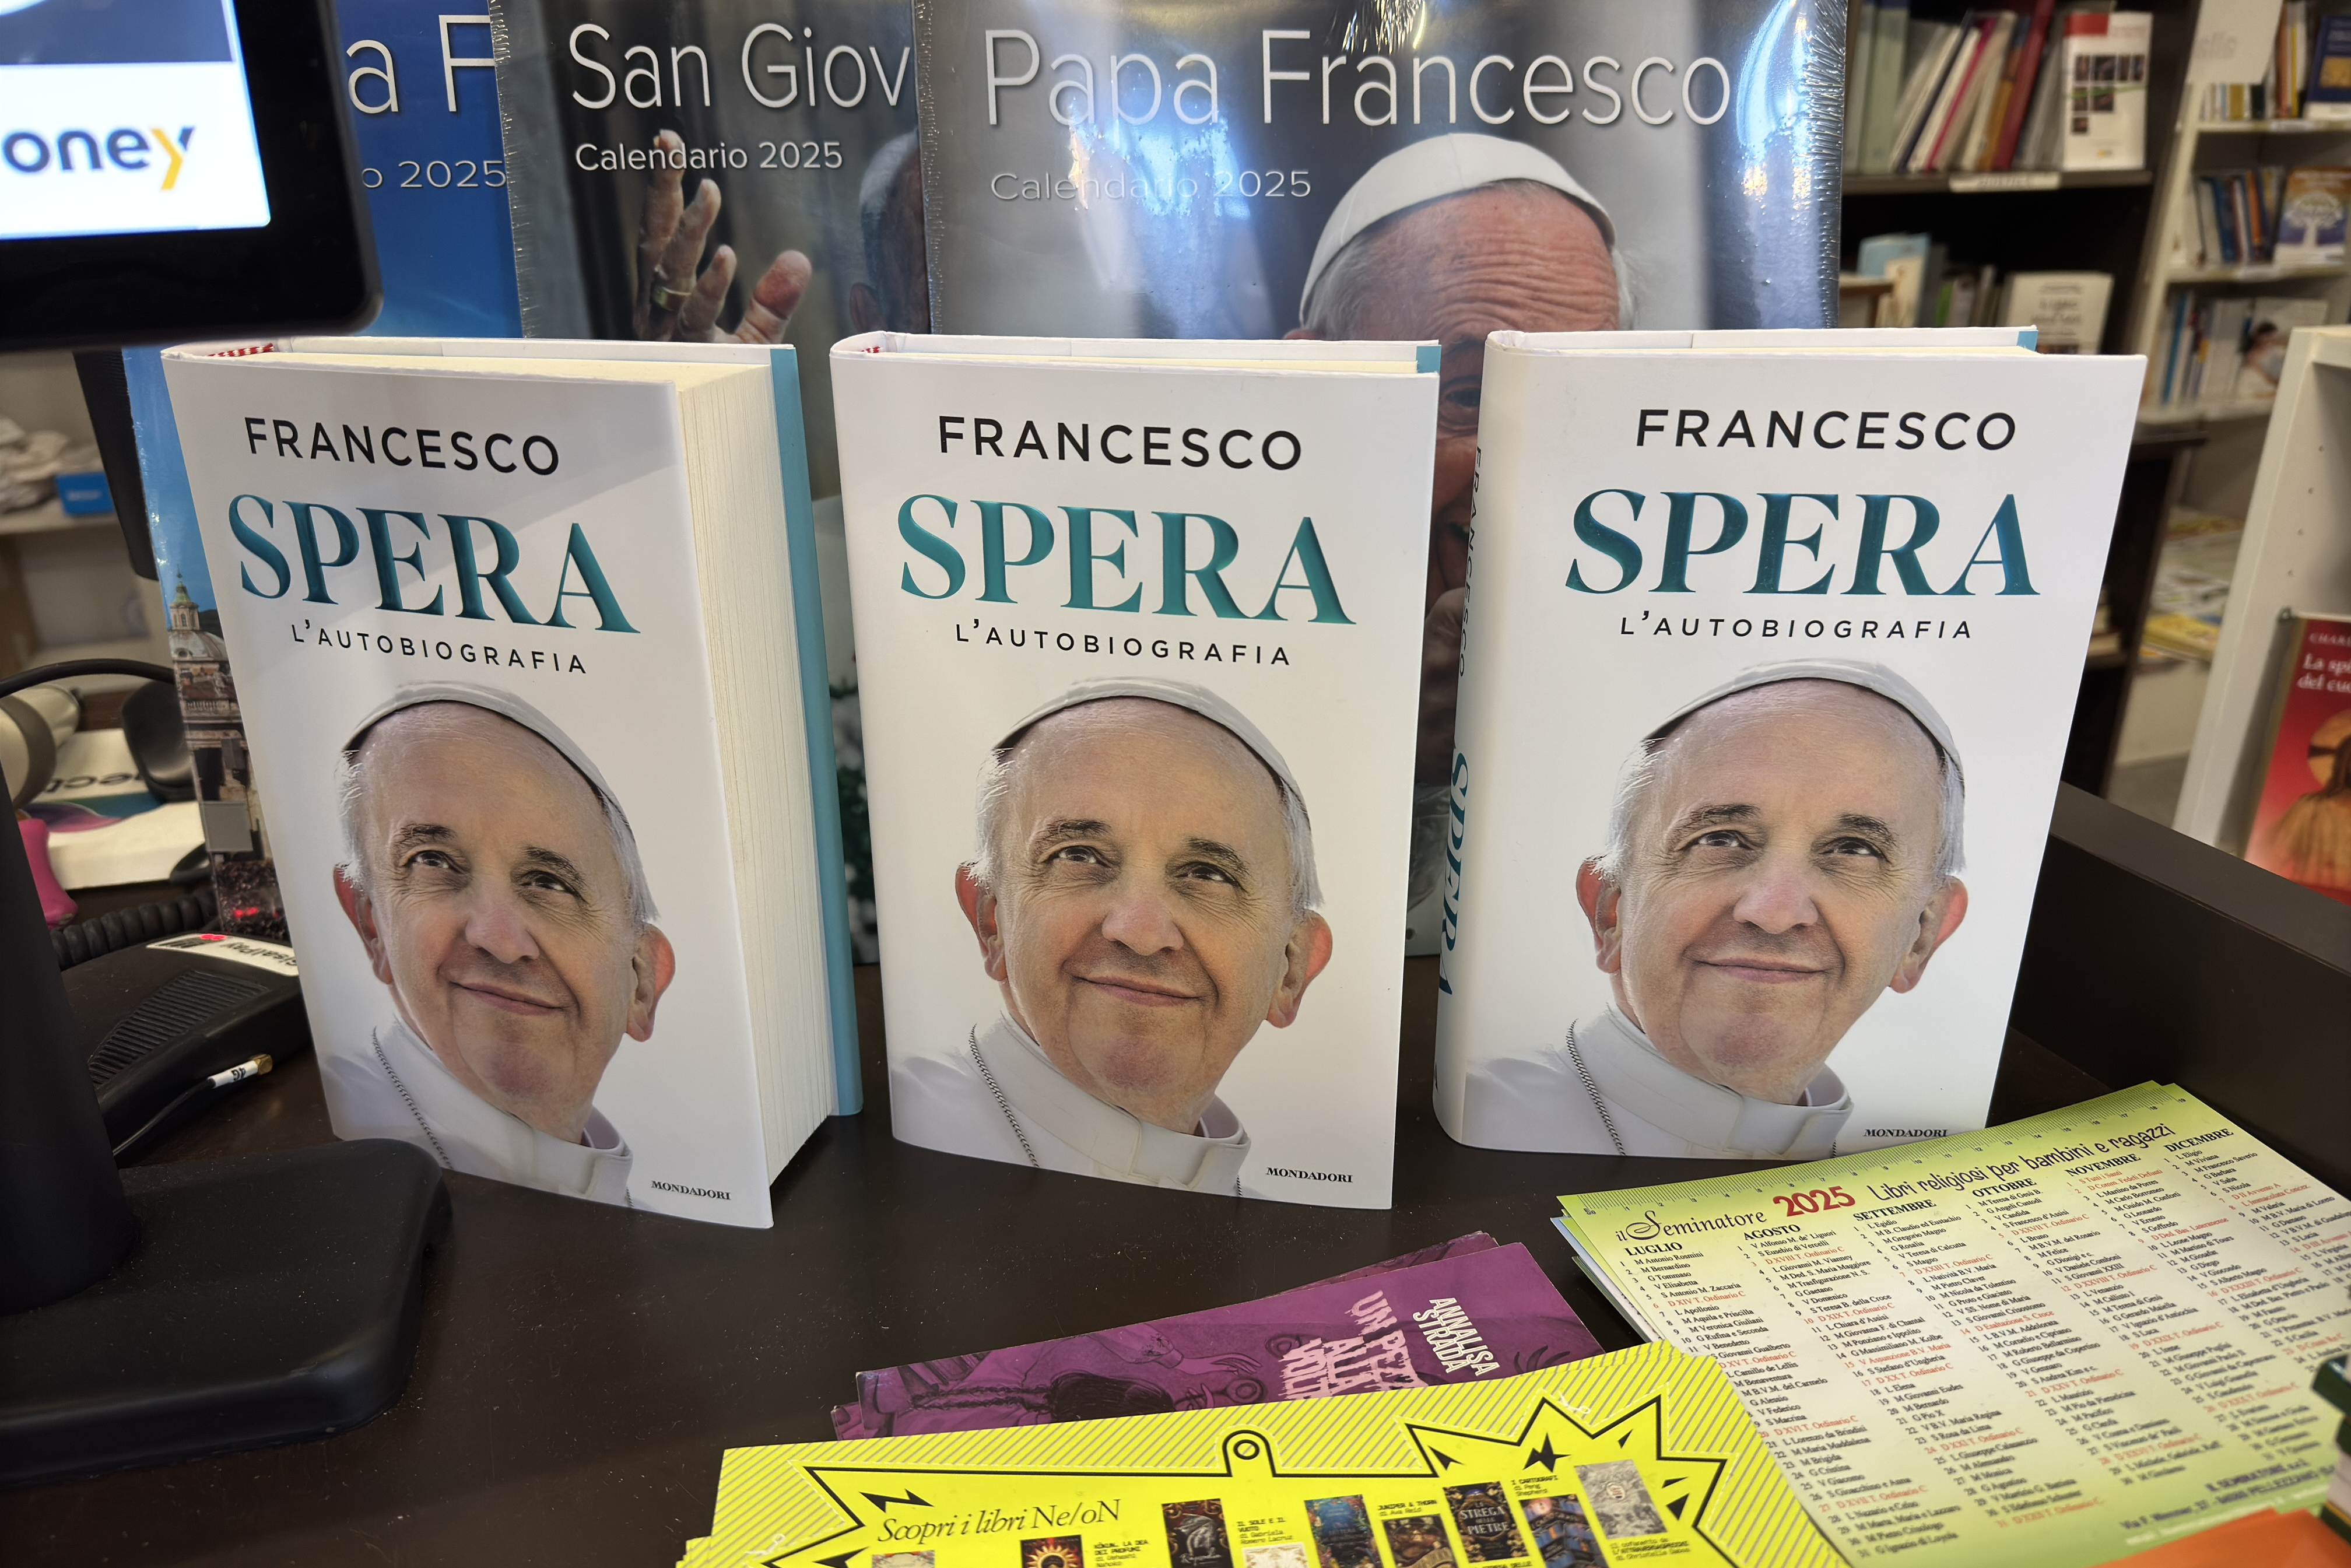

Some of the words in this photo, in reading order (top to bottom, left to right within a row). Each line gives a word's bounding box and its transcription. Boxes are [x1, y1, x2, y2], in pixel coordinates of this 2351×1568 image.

[570, 23, 711, 109] San
[741, 23, 910, 108] Giov
[985, 29, 1219, 143] Papa
[1262, 29, 1731, 127] Francesco
[575, 142, 748, 171] Calendario
[759, 142, 843, 170] 2025
[398, 160, 506, 189] 2025
[991, 171, 1198, 201] Calendario
[1213, 170, 1311, 198] 2025
[1636, 409, 2016, 451] FRANCESCO
[244, 417, 559, 475] FRANCESCO
[939, 415, 1301, 470] FRANCESCO
[1564, 488, 2040, 595] SPERA
[229, 494, 641, 634] SPERA
[897, 494, 1356, 625] SPERA
[1459, 446, 1481, 677] FRANCESCO
[1620, 611, 1971, 639] L'AUTOBIOGRAFIA
[292, 619, 586, 673] L'AUTOBIOGRAFIA
[956, 619, 1290, 665] L'AUTOBIOGRAFIA
[1864, 1128, 1949, 1138] MONDADORI
[2163, 1128, 2234, 1152] DICEMBRE
[2181, 1149, 2203, 1158] Eligio
[2201, 1159, 2235, 1171] Francesco
[2232, 1152, 2258, 1162] Saverio
[1265, 1167, 1353, 1183] MONDADORI
[2064, 1153, 2141, 1177] NOVEMBRE
[651, 1180, 731, 1200] MONDADORI
[1615, 1230, 1627, 1242] il
[1626, 1210, 1767, 1241] Seminatore
[1772, 1185, 1857, 1218] 2025
[1867, 1178, 1915, 1202] Libri
[1918, 1167, 1989, 1194] religiosi
[1987, 1161, 2021, 1181] per
[2019, 1139, 2093, 1170] bambini
[2096, 1141, 2110, 1155] e
[2109, 1123, 2176, 1150] ragazzi
[1972, 1178, 2037, 1197] OTTOBRE
[2101, 1187, 2129, 1197] Martino
[2136, 1180, 2159, 1188] Porres
[1995, 1203, 2017, 1212] Angeli
[2016, 1197, 2043, 1207] Custodi
[2113, 1195, 2134, 1203] Carlo
[2131, 1187, 2164, 1198] Borromeo
[1852, 1199, 1937, 1222] SETTEMBRE
[2008, 1216, 2043, 1227] Francesco
[2042, 1209, 2069, 1220] d'Assisi
[1743, 1224, 1801, 1240] AGOSTO
[1873, 1219, 1897, 1228] Egidio
[1624, 1242, 1683, 1256] LUGLIO
[1760, 1240, 1788, 1248] Alfonso
[1809, 1230, 1837, 1239] Liguori
[1645, 1255, 1673, 1264] Antonio
[1672, 1251, 1704, 1260] Rosmini
[1905, 1250, 1931, 1258] Teresa
[1937, 1242, 1967, 1251] Calcutta
[1650, 1262, 1691, 1272] Bernardino
[1780, 1261, 1813, 1272] Giovanni
[1822, 1255, 1853, 1264] Vianney
[1662, 1281, 1699, 1289] Elisabetta
[1802, 1286, 1833, 1296] Gaetano
[1703, 1292, 1739, 1302] Ordinario
[1345, 1290, 1398, 1337] UN
[1413, 1309, 1471, 1374] STRADA
[1429, 1297, 1500, 1376] ANNALISA
[878, 1515, 958, 1545] Scopri
[960, 1514, 972, 1535] i
[976, 1509, 1028, 1534] libri
[1031, 1499, 1121, 1528] Ne/oN
[1459, 1506, 1505, 1520] STREGA
[1467, 1521, 1509, 1535] PIETRE
